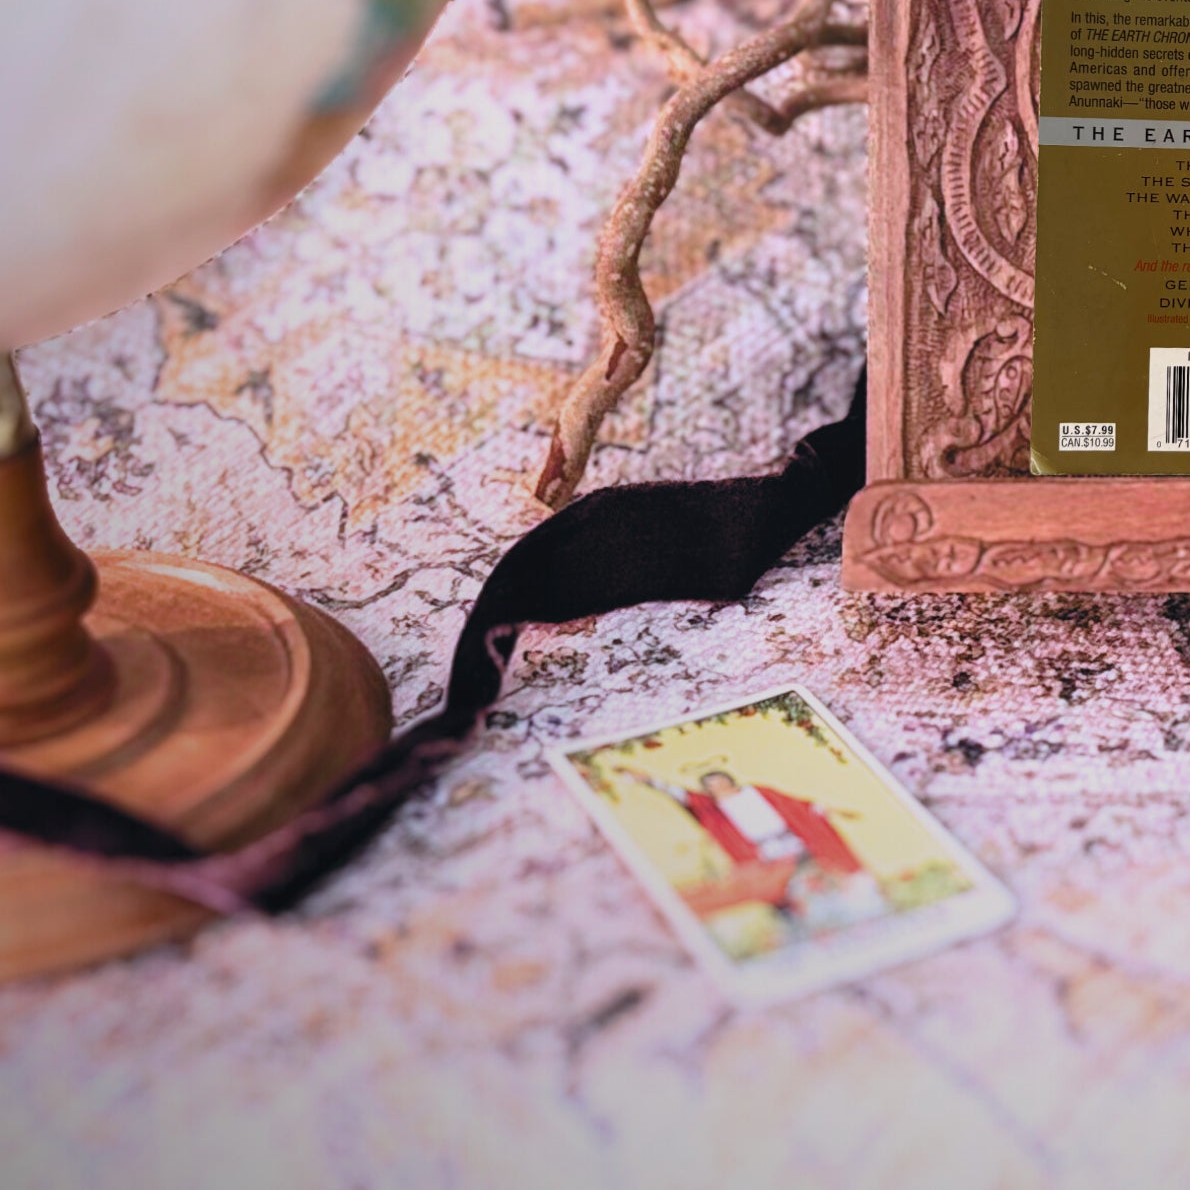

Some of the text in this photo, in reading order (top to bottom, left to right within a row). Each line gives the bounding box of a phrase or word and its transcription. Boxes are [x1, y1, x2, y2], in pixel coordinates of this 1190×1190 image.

[1085, 12, 1109, 26] this,
[1086, 28, 1109, 41] THE
[1111, 29, 1151, 42] EARTH
[1070, 44, 1139, 60] long-hidden
[1142, 48, 1184, 61] secrets
[1069, 61, 1127, 75] Americas
[1133, 64, 1156, 76] and
[1069, 79, 1121, 92] spawned
[1125, 79, 1144, 92] the
[1072, 125, 1124, 141] THE
[1141, 176, 1175, 187] THE
[1126, 192, 1159, 203] THE
[1134, 259, 1158, 273] And
[1160, 259, 1179, 273] the
[1148, 314, 1188, 324] Illustrated
